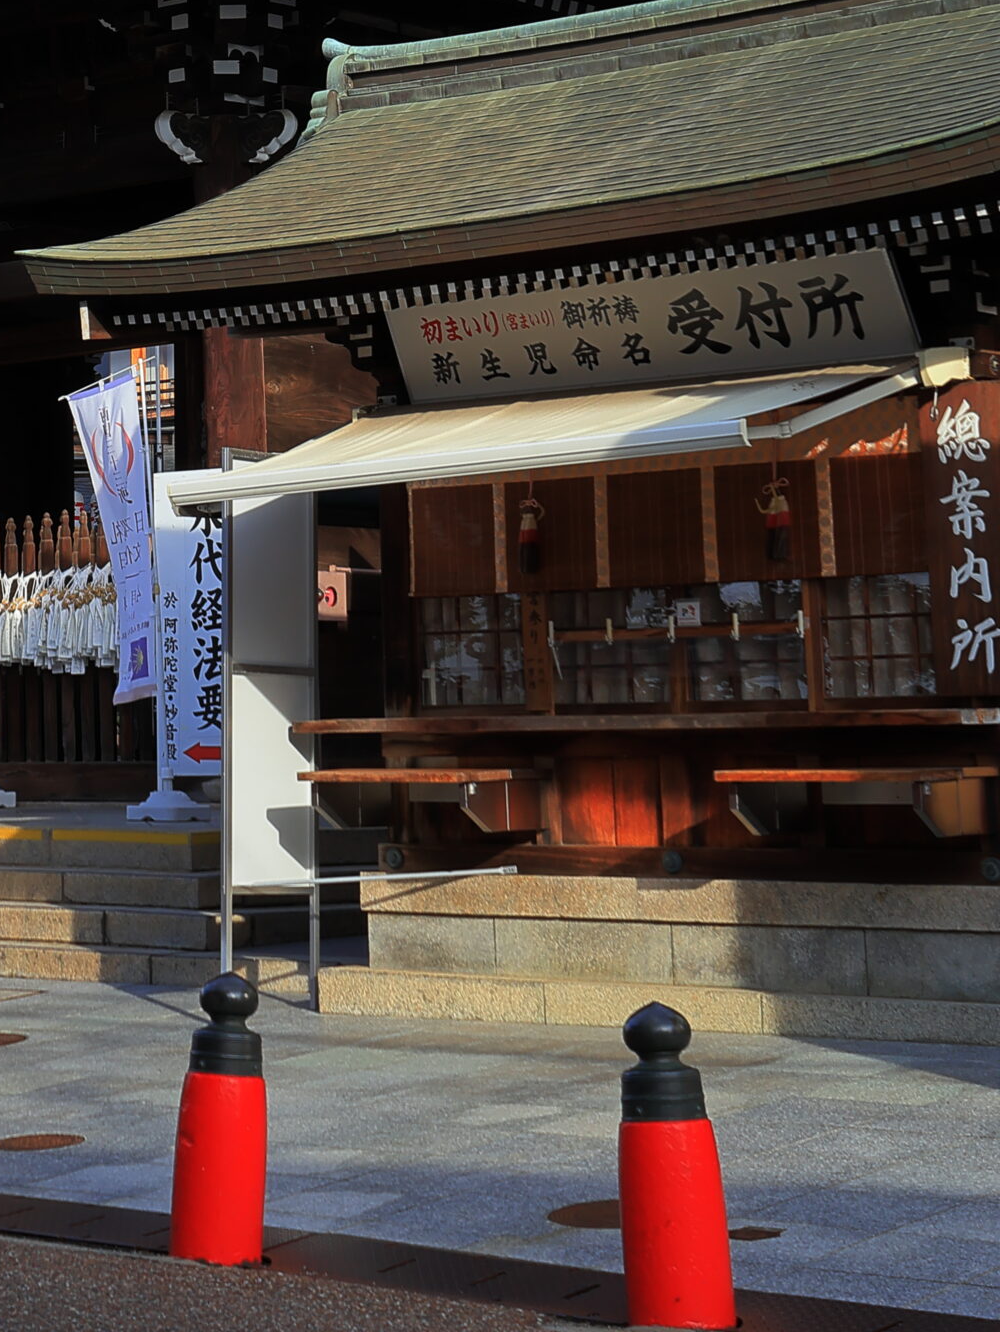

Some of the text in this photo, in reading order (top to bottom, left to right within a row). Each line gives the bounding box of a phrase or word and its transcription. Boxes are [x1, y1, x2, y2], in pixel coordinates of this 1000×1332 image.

[667, 273, 865, 354] 受付所
[431, 332, 651, 385] 新生児命名
